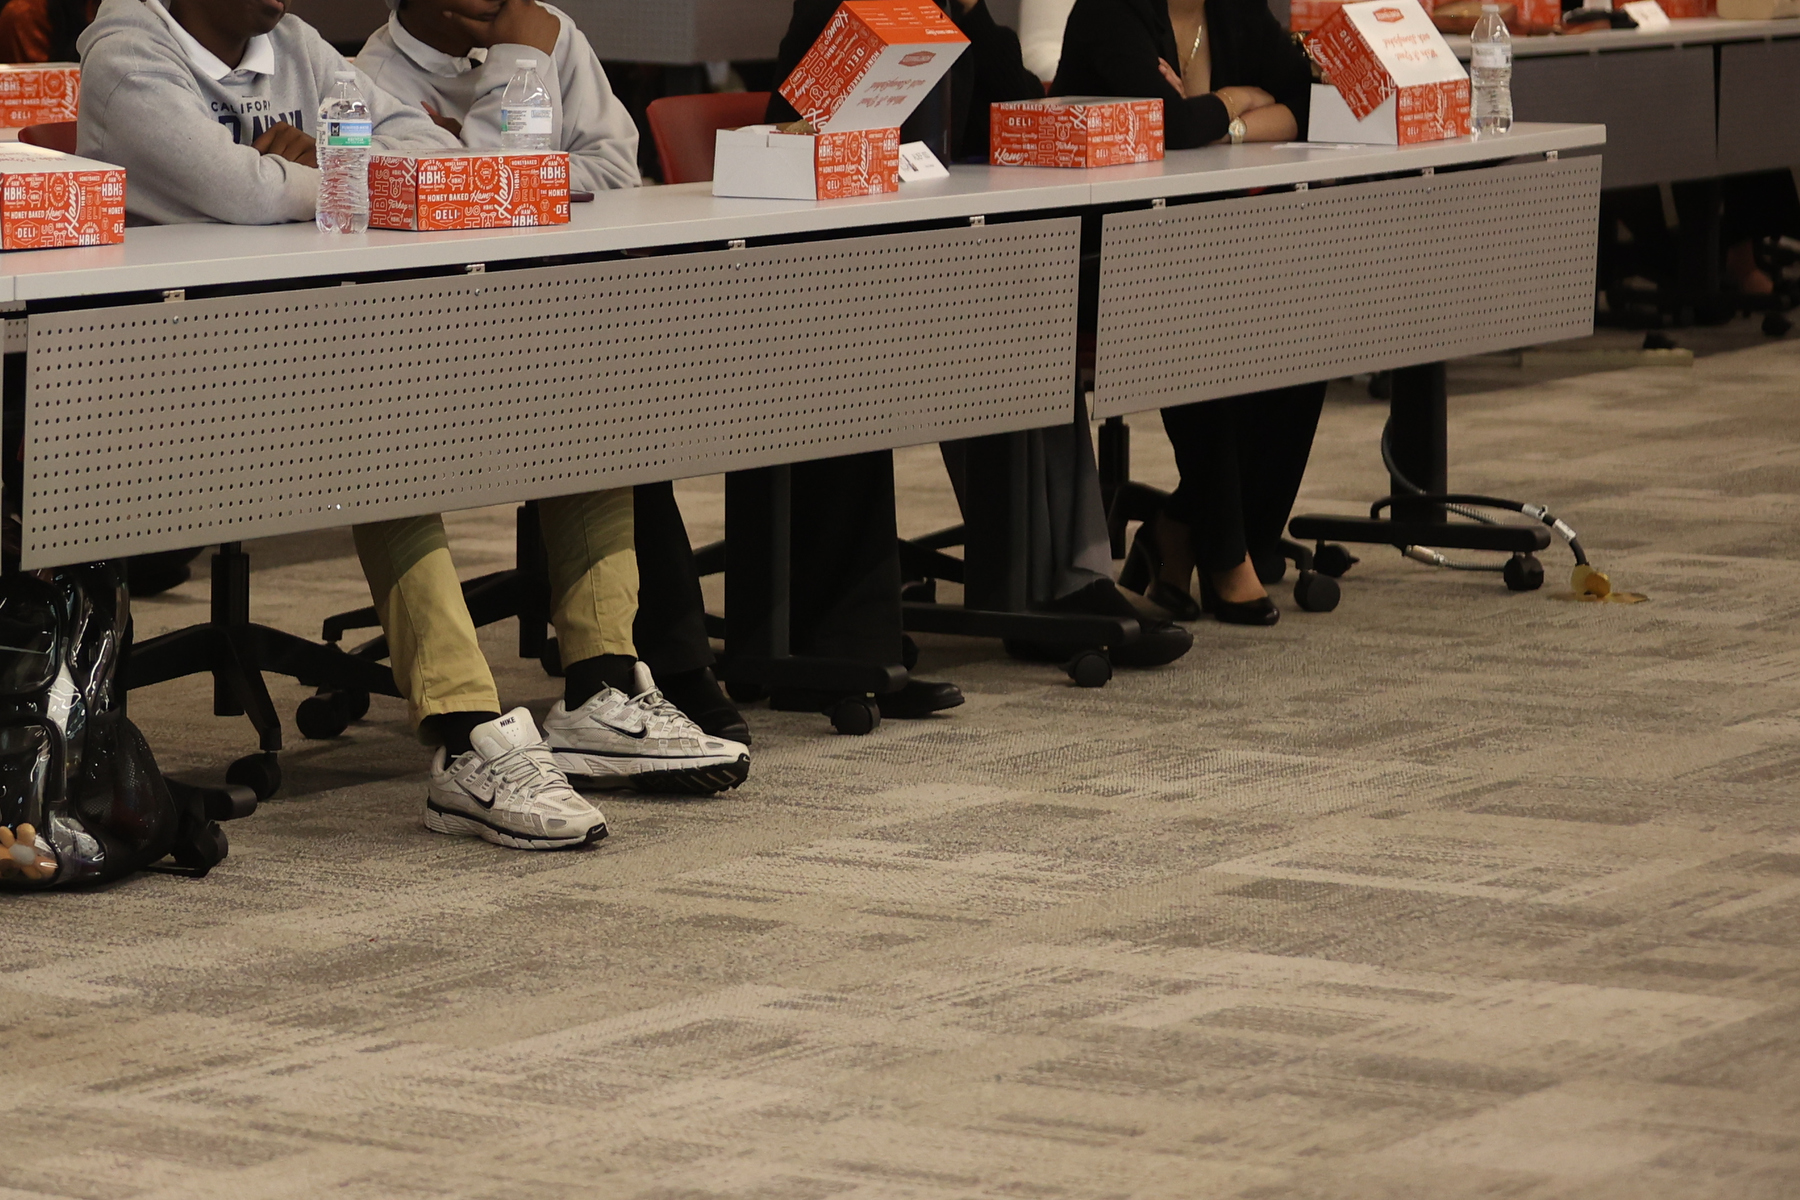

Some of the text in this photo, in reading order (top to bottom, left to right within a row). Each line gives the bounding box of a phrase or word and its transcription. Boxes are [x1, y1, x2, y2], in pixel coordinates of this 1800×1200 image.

[1340, 29, 1358, 53] DELI
[844, 47, 864, 72] DELI
[863, 51, 880, 72] HONEY
[847, 71, 865, 92] BAKED
[211, 100, 271, 114] CALIFOR
[1001, 103, 1020, 111] HONEY
[11, 110, 31, 120] DELI
[1008, 117, 1031, 126] DELI
[418, 171, 440, 184] HBH
[540, 167, 560, 179] HBH
[427, 194, 447, 202] HONEY
[448, 193, 469, 201] BAKED
[548, 189, 568, 197] HONEY
[11, 210, 28, 219] HONEY
[28, 209, 45, 219] BAKED
[108, 206, 124, 215] HONEY
[435, 209, 458, 220] DELI
[555, 204, 568, 214] DE
[17, 227, 36, 238] DELI
[114, 223, 124, 234] DE
[500, 716, 516, 727] NIKE
